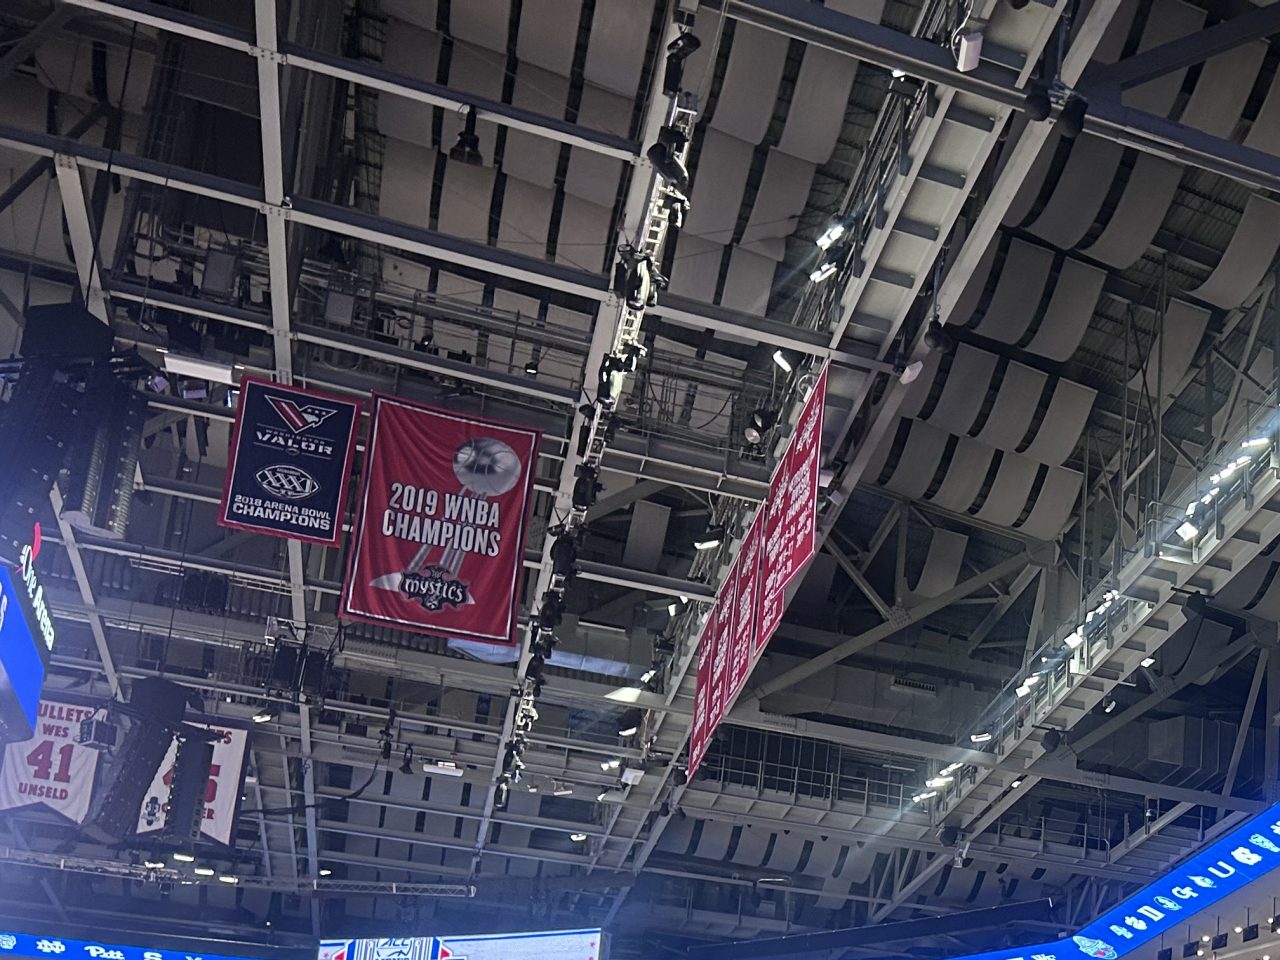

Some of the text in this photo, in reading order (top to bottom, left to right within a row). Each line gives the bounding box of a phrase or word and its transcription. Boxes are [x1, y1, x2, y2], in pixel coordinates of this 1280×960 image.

[256, 431, 333, 455] VALOR
[232, 503, 331, 531] CHAMPIONS
[234, 494, 331, 520] 2018 ARENA BOWL
[389, 482, 500, 529] 2019 WNBA
[382, 508, 501, 557] CHAMPIONS
[33, 585, 55, 651] Arena
[39, 703, 92, 723] ULLETS
[42, 723, 69, 738] WES
[26, 740, 74, 783] 41
[18, 782, 68, 800] UNSELD
[84, 945, 125, 960] Pitt
